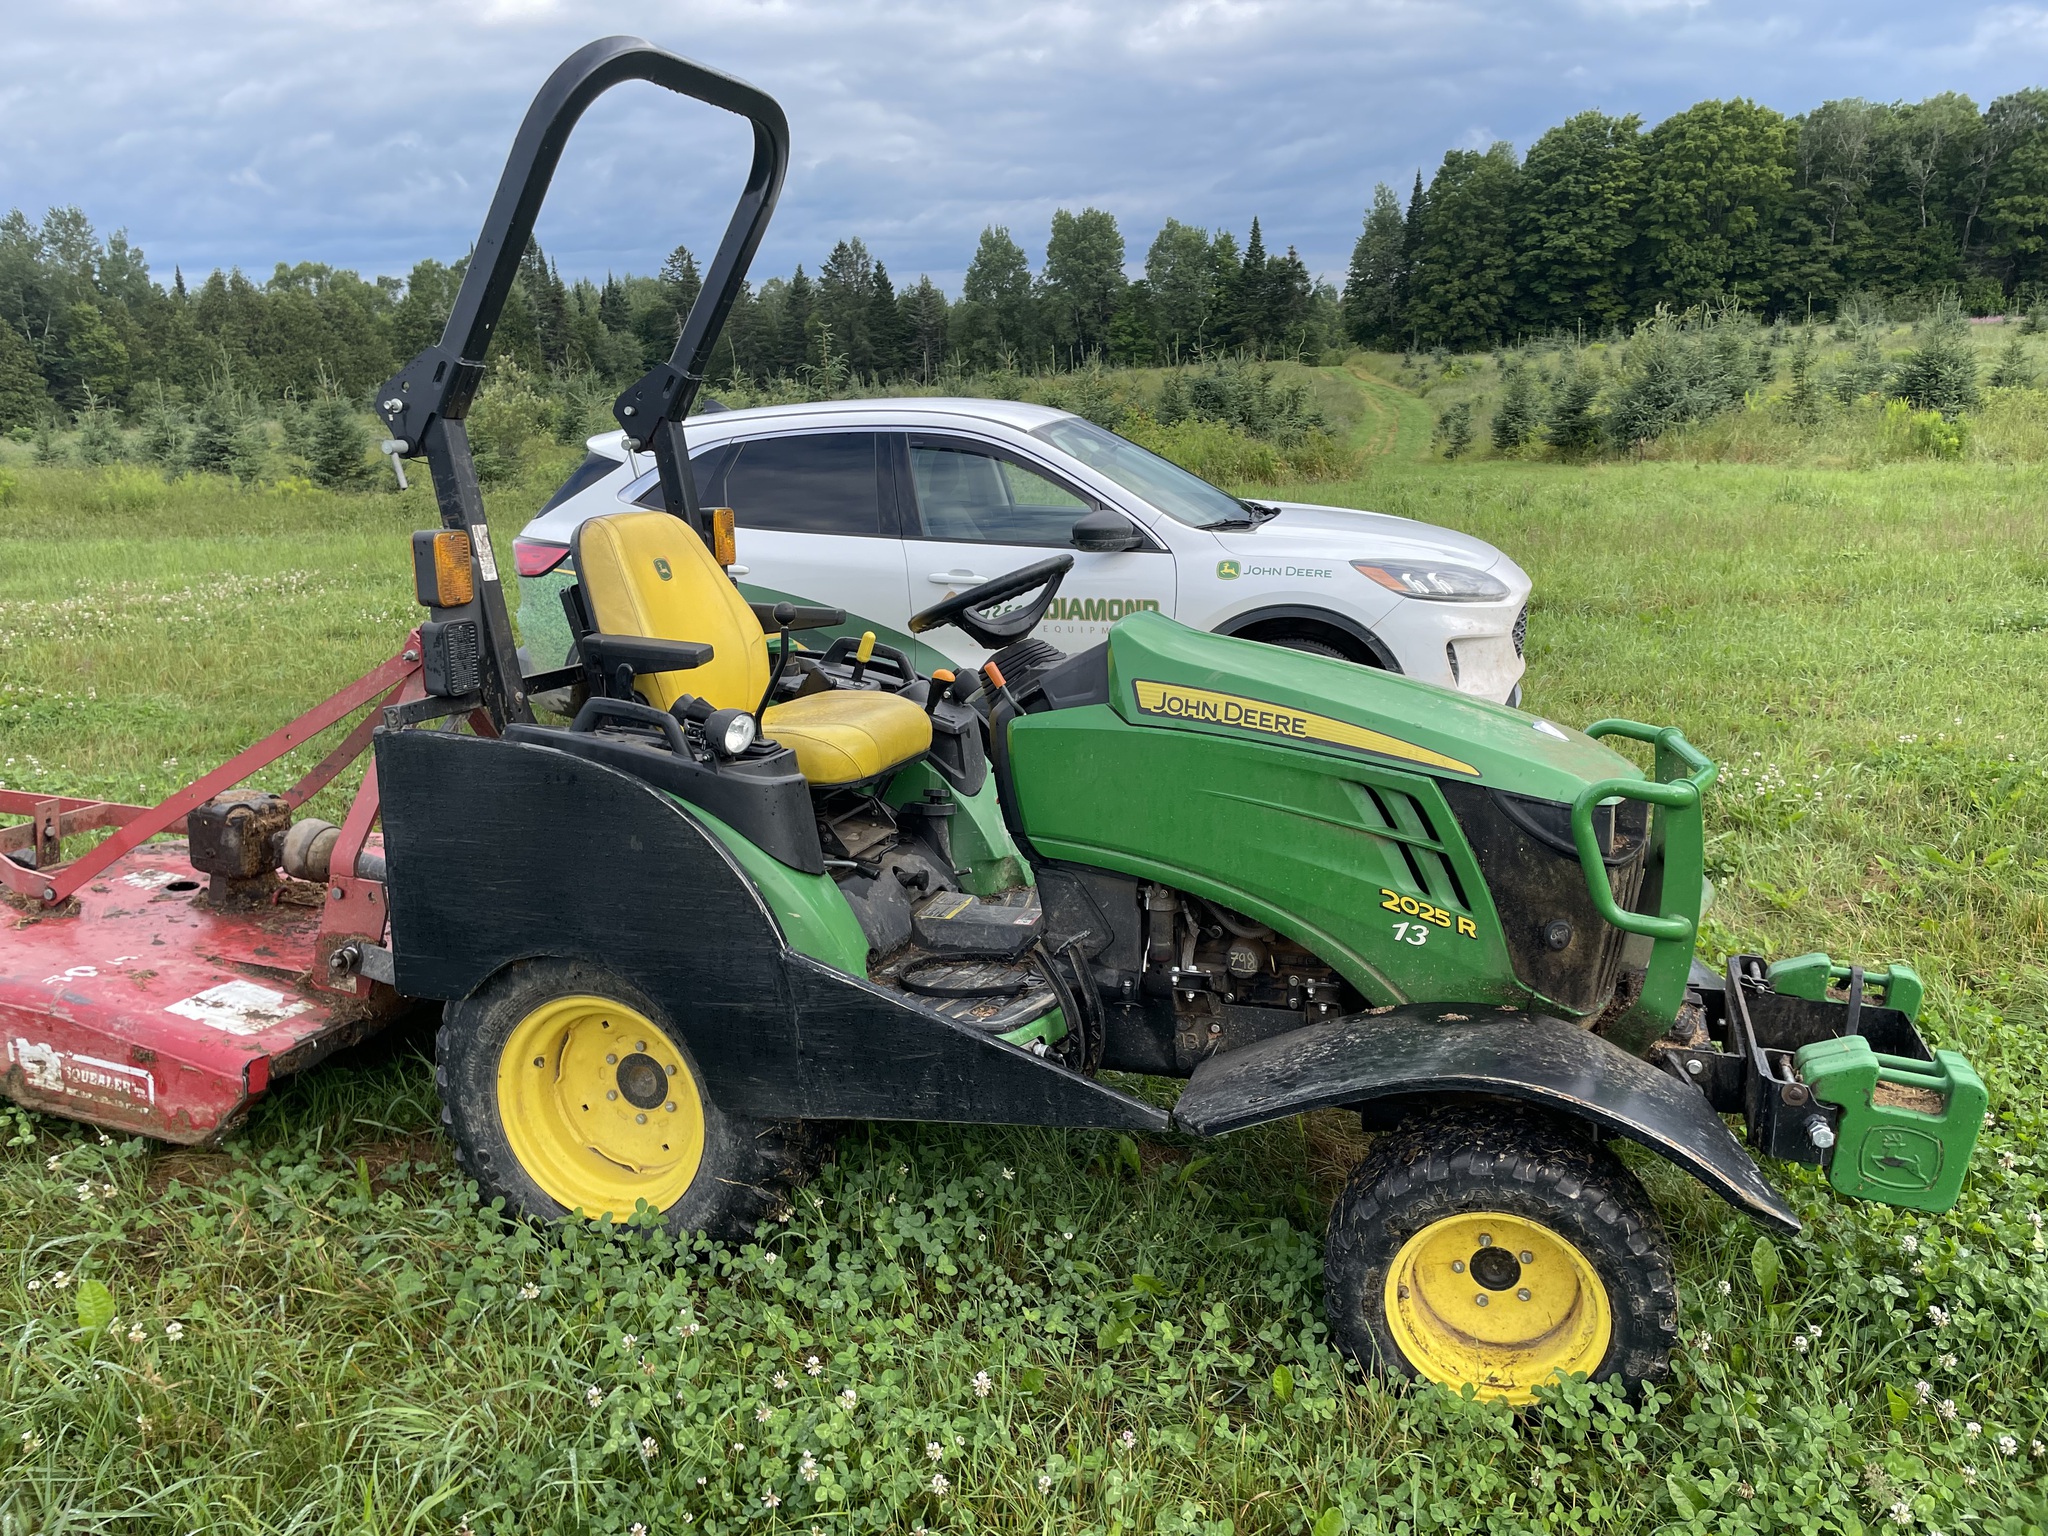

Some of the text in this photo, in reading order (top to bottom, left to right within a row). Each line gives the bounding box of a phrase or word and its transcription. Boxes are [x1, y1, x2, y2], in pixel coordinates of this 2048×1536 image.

[1243, 565, 1332, 578] JOHN DEERE
[1043, 625, 1111, 634] EQUIPM
[1153, 692, 1307, 735] JOHN DEERE
[1380, 888, 1477, 940] 2025 R
[1392, 921, 1429, 946] 13
